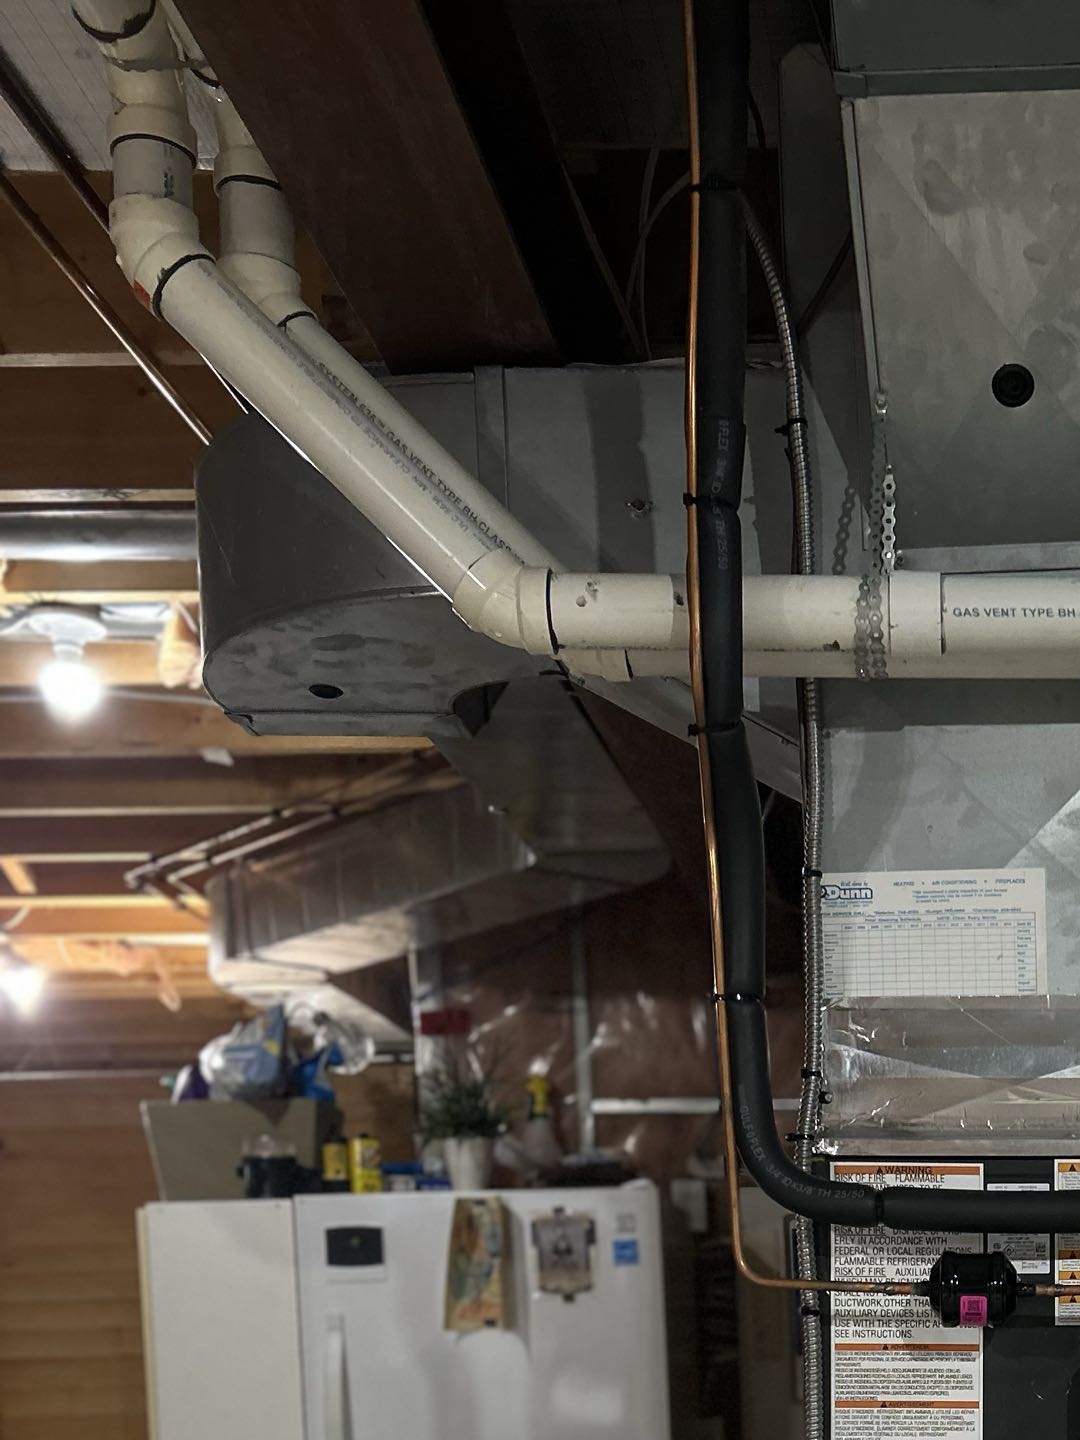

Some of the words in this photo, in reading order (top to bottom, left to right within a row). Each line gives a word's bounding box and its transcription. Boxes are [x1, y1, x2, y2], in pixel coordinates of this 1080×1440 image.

[407, 452, 436, 480] VENT
[434, 478, 462, 506] TYPE
[716, 539, 728, 570] 25/50
[953, 608, 980, 618] GAS
[984, 607, 1017, 618] VENT
[1021, 607, 1054, 619] TYPE
[1058, 607, 1076, 618] BH
[885, 1165, 932, 1174] WARNING
[835, 1174, 854, 1182] RISK
[856, 1174, 867, 1182] OF
[869, 1174, 886, 1182] FIRE
[895, 1174, 944, 1182] FLAMMABLE
[835, 1227, 853, 1235] RISK
[855, 1227, 866, 1235] OF
[868, 1227, 885, 1235] FIRE
[835, 1237, 855, 1245] ERLY
[858, 1237, 866, 1245] IN
[868, 1237, 924, 1245] ACCORDANCE
[926, 1237, 947, 1245] WITH
[835, 1247, 870, 1255] FEDERAL
[873, 1247, 884, 1255] OR
[887, 1247, 913, 1255] LOCAL
[835, 1268, 853, 1276] RISK
[856, 1268, 867, 1276] OF
[868, 1268, 885, 1276] FIRE
[835, 1299, 880, 1307] DUCTWORK
[881, 1299, 911, 1307] OTHER
[835, 1320, 851, 1328] USE
[853, 1320, 874, 1328] WITH
[878, 1320, 892, 1328] THE
[895, 1320, 931, 1328] SPECIFIC
[835, 1330, 849, 1338] SEE
